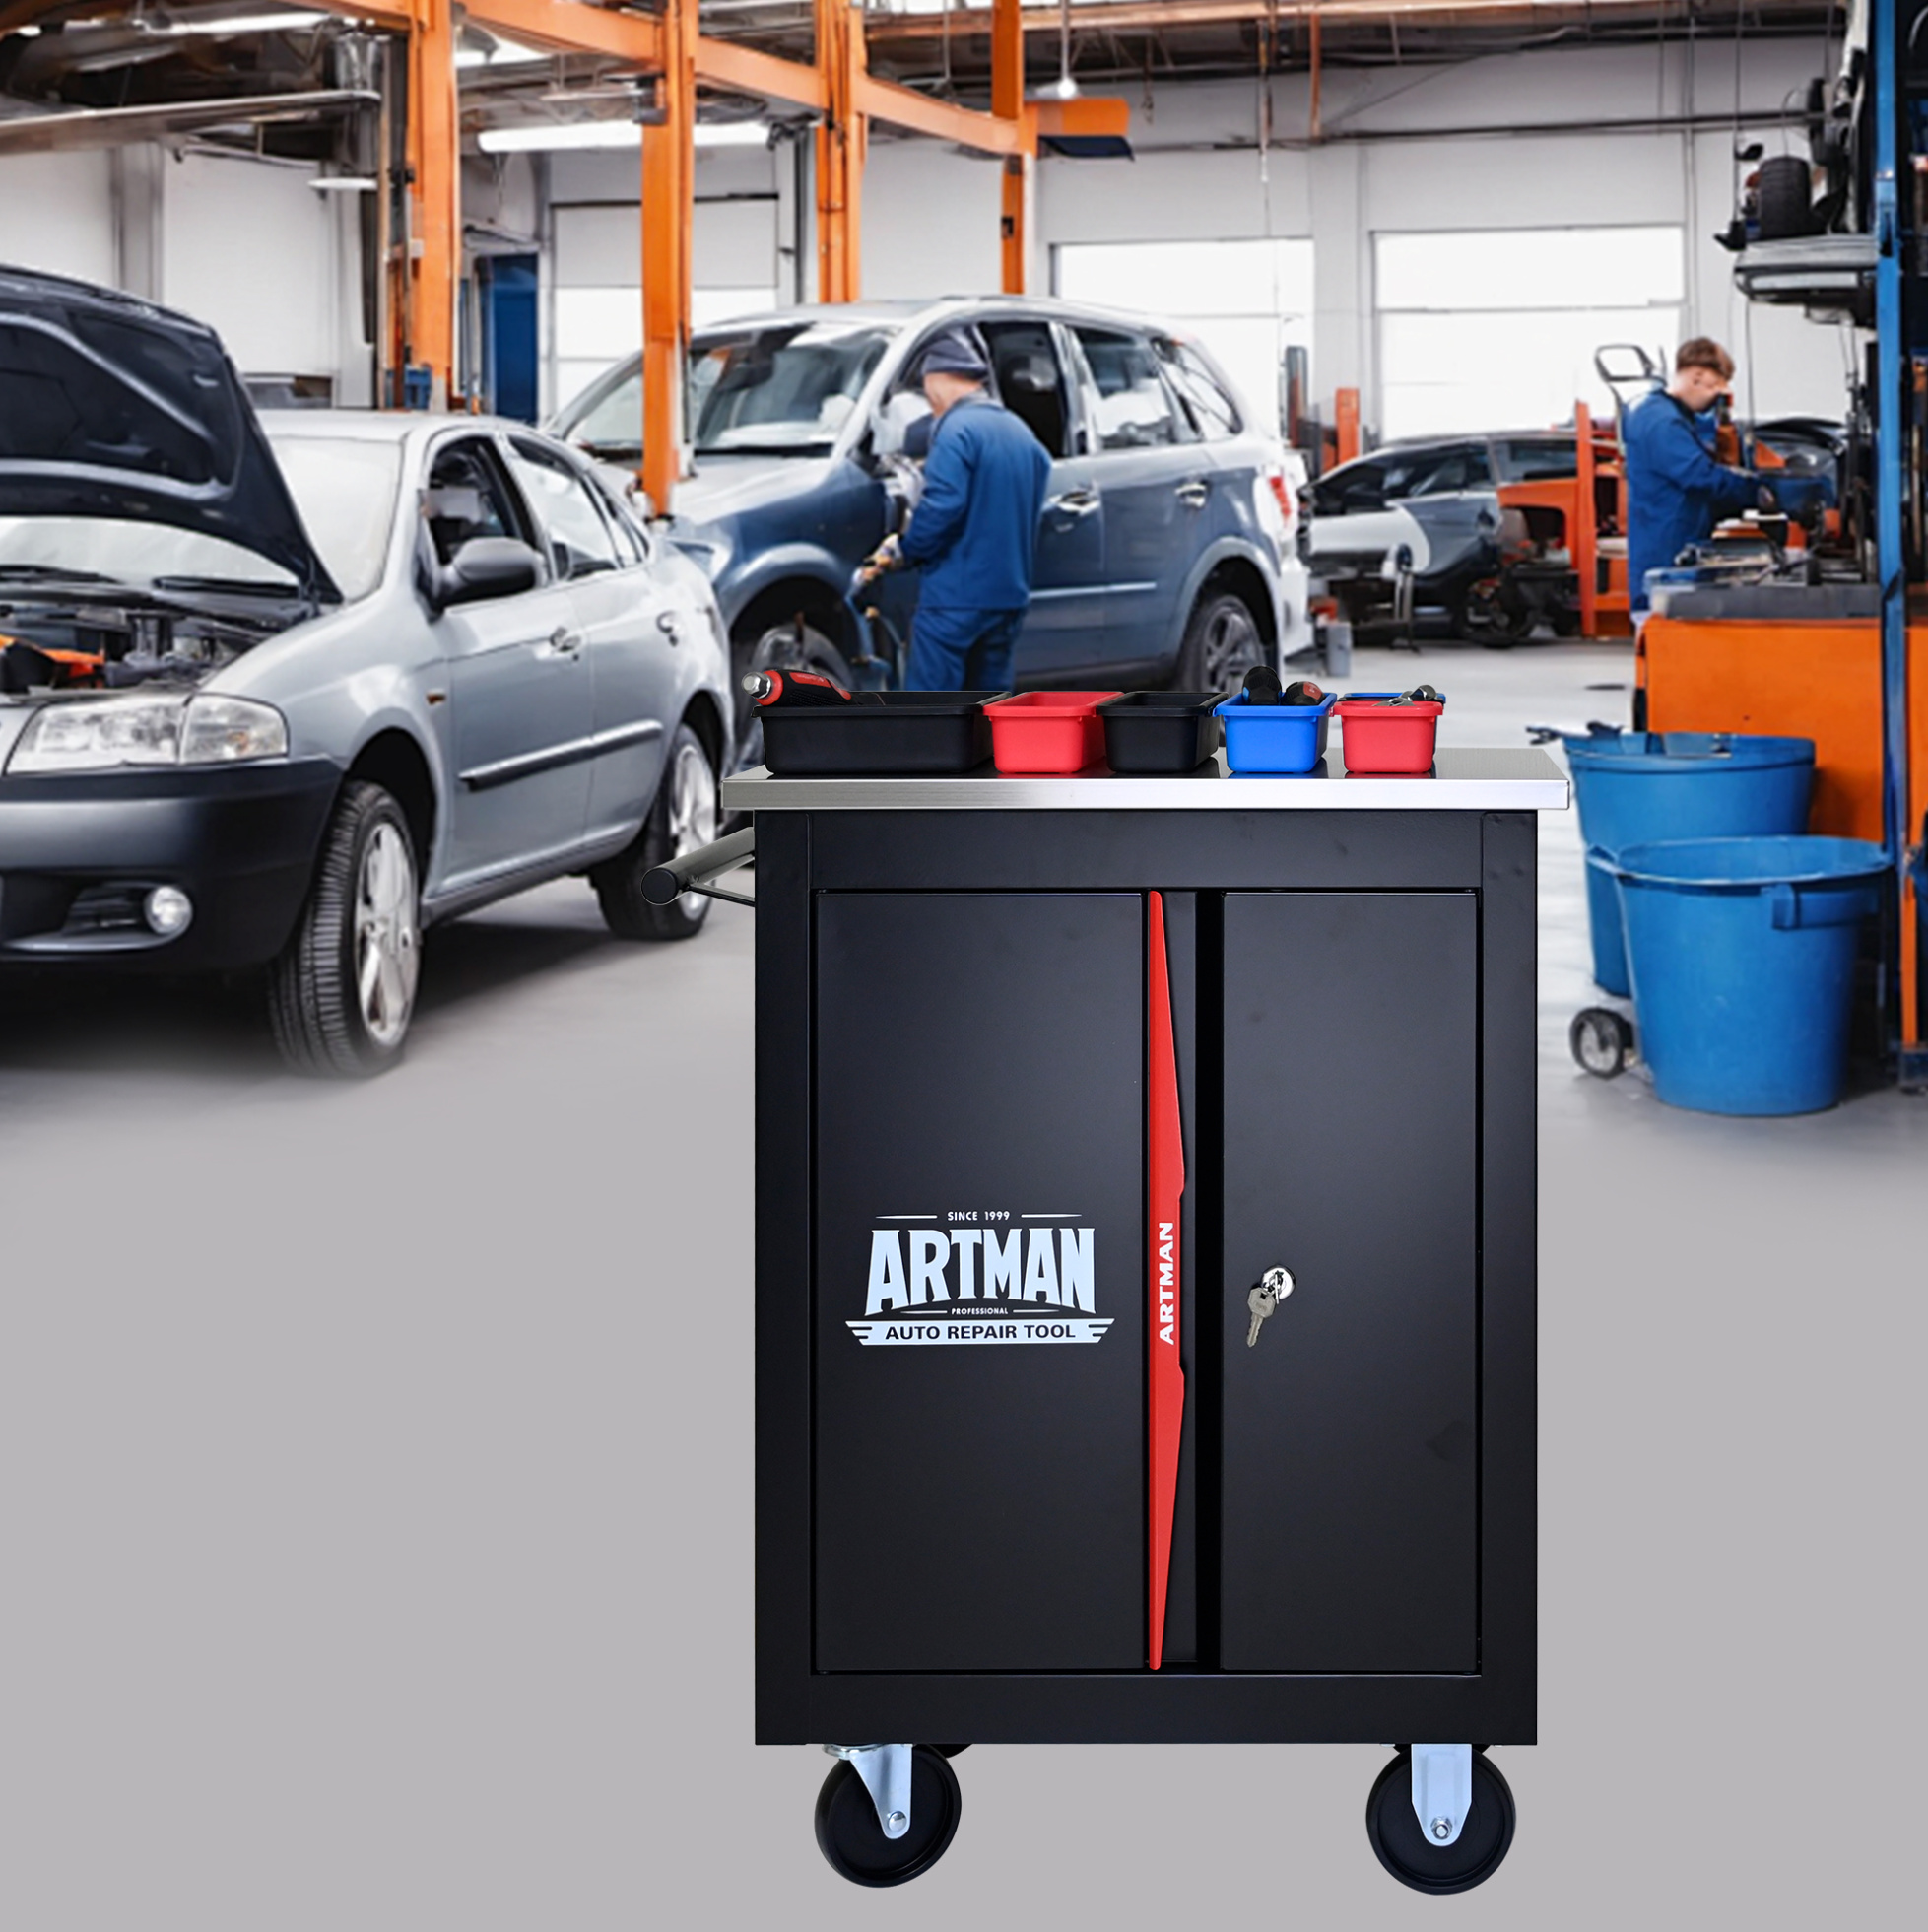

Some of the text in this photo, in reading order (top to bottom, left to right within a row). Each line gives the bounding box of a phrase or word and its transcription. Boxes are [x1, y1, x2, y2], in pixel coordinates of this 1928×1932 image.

[947, 1210, 1011, 1222] SINCE 1999
[864, 1228, 1097, 1317] ARTMAN
[1158, 1222, 1175, 1346] ARTMAN
[951, 1307, 1009, 1316] PROFESSIONAL
[885, 1324, 1076, 1340] AUTO REPAIR TOOL
